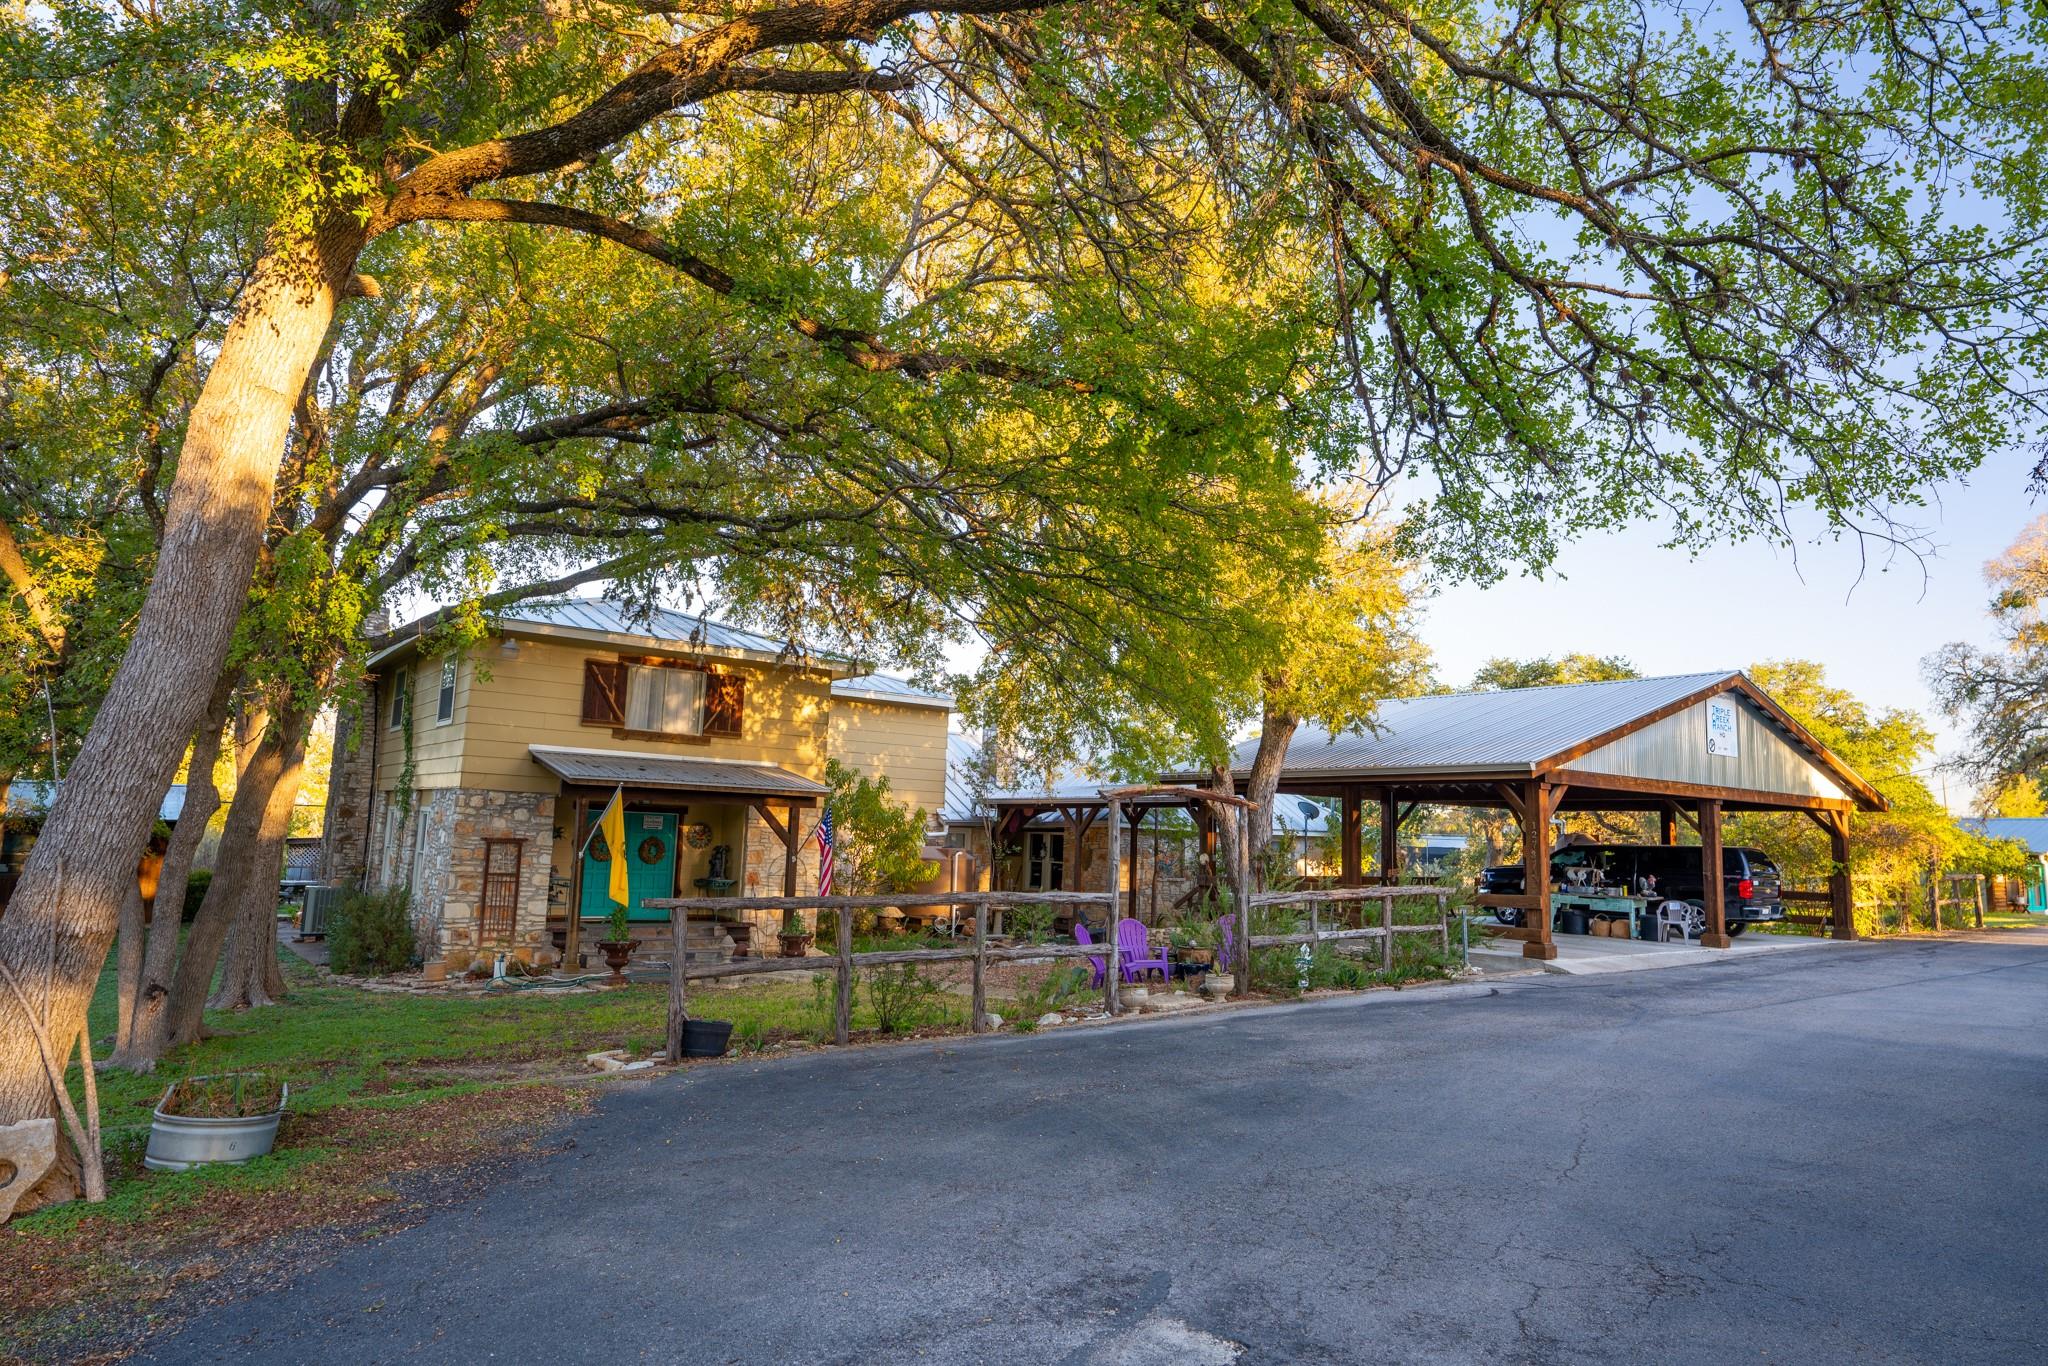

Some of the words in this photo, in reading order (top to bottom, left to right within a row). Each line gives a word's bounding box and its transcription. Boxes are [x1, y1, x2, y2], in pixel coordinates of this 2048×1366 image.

[1712, 705, 1731, 716] TRIPLE
[1712, 713, 1729, 723] CREEK
[1712, 720, 1732, 732] RANCH
